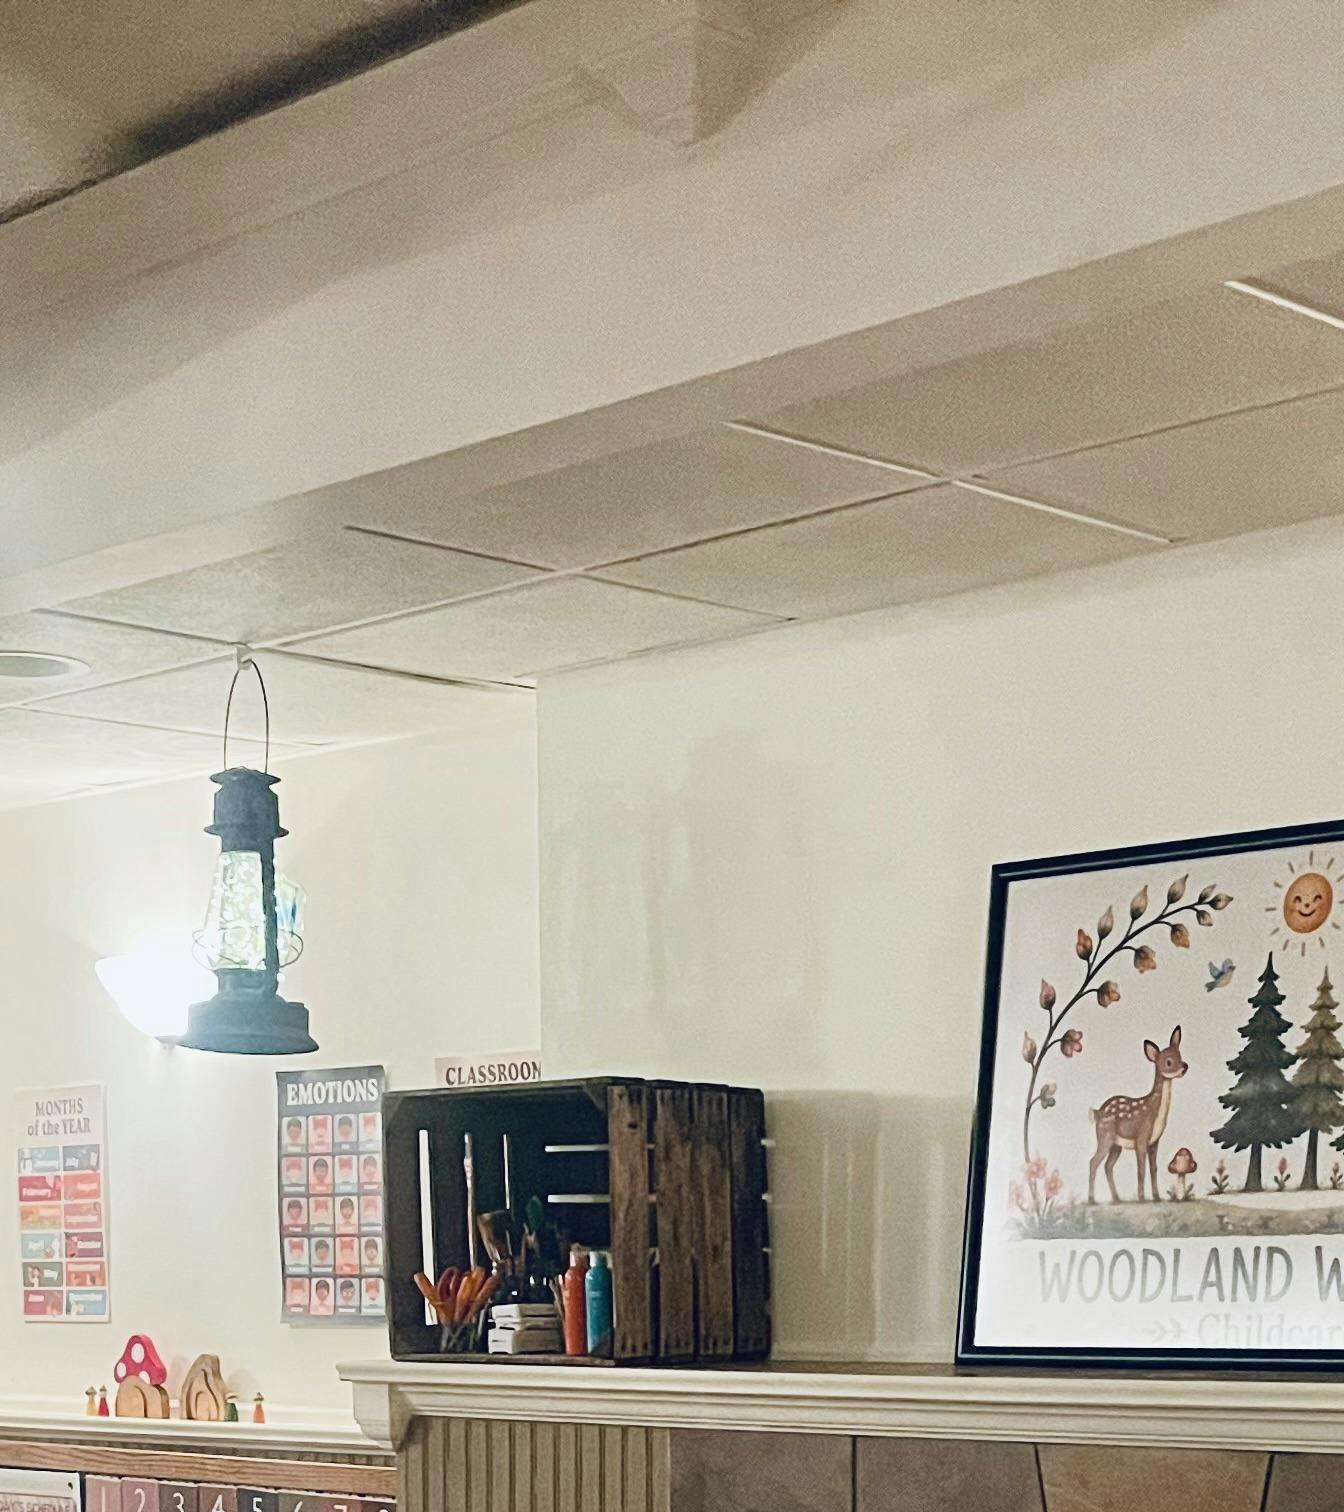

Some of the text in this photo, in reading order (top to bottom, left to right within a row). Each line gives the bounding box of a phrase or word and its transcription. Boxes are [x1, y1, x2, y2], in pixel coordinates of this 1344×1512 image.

[286, 1078, 379, 1106] EMOTIONS
[35, 1097, 84, 1116] MONTHS
[27, 1117, 92, 1136] of the YEAR
[1038, 1246, 1294, 1303] WOODLAND
